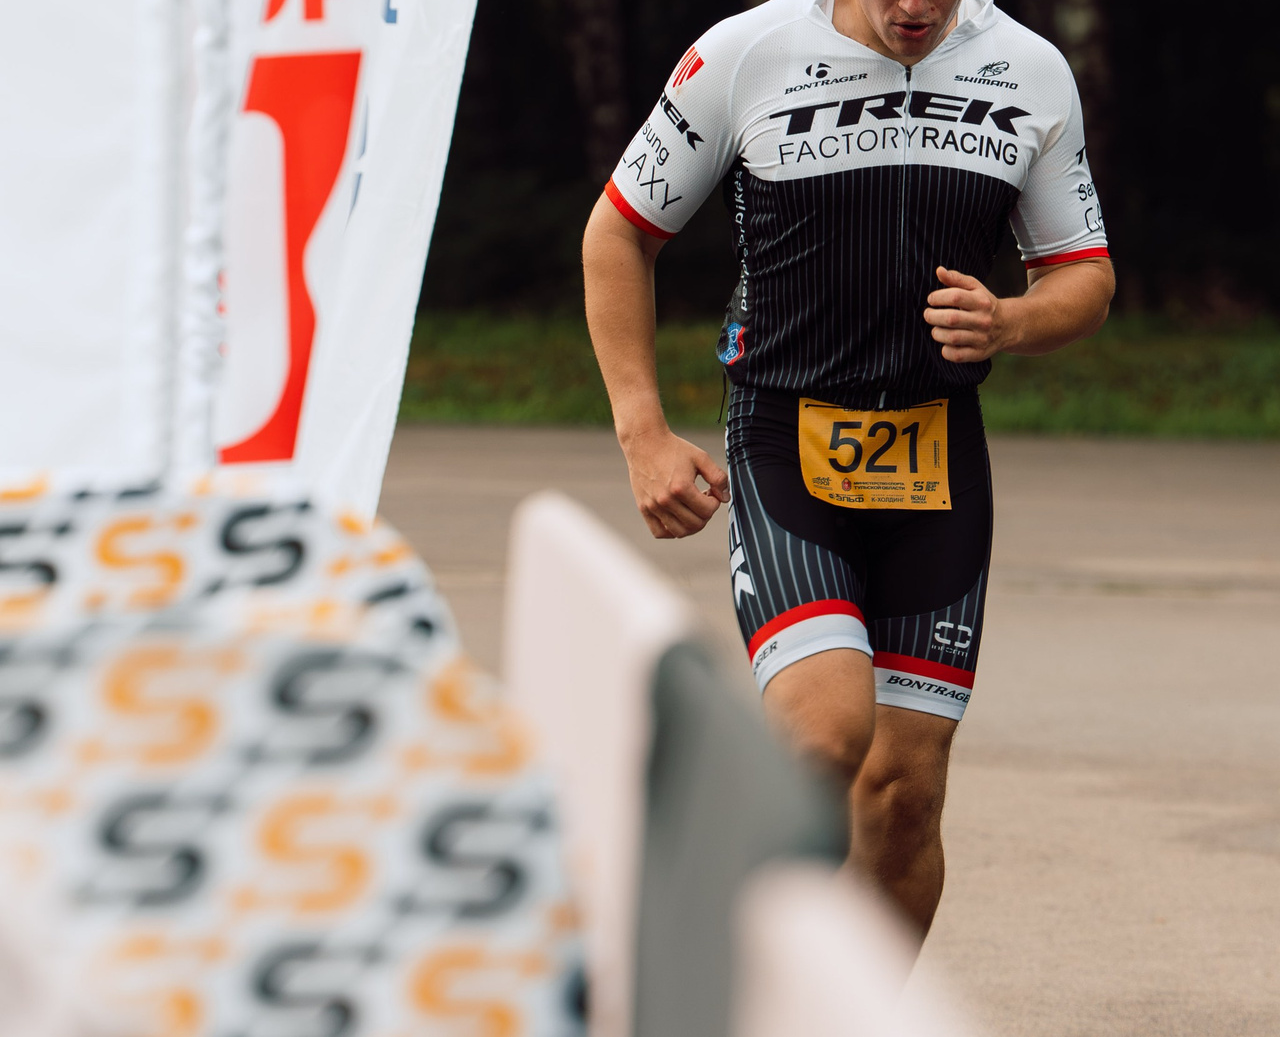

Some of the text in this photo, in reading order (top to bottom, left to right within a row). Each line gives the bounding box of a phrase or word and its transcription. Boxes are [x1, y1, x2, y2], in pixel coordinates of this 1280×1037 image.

[784, 72, 868, 95] BONTRAGER
[954, 74, 1018, 90] SHIMANO
[768, 90, 1032, 137] TREK
[828, 421, 920, 473] 521
